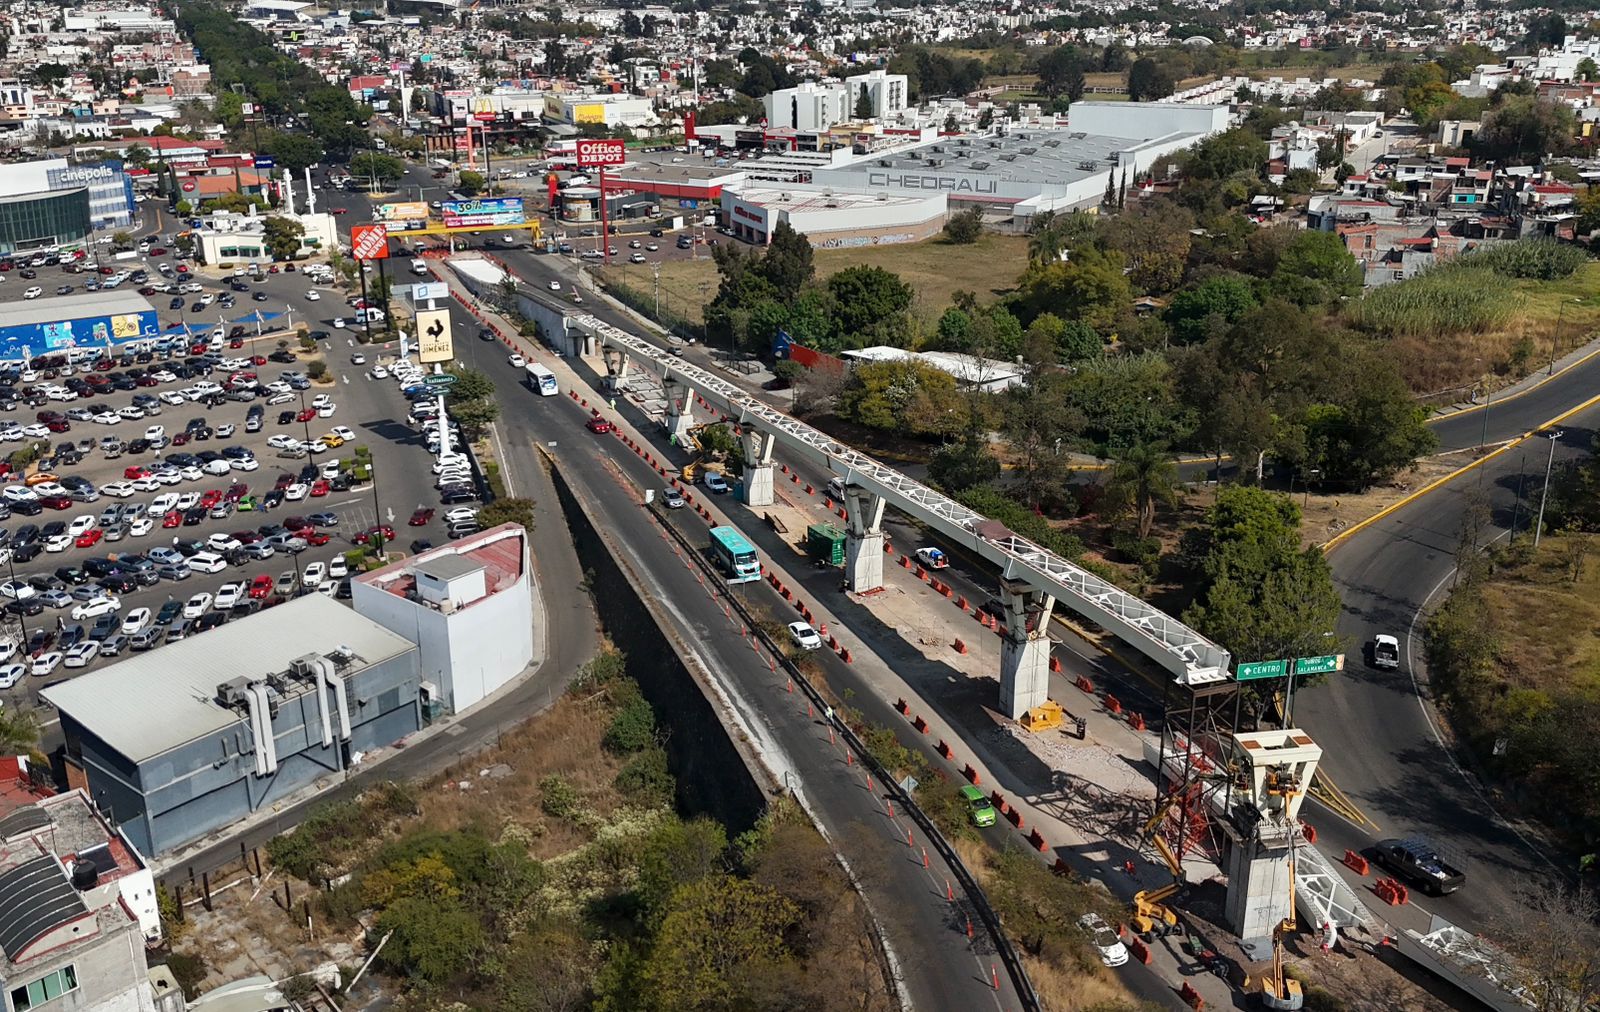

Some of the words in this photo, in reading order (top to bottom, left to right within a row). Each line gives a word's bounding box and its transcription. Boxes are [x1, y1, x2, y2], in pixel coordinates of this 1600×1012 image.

[580, 143, 622, 154] Office
[581, 153, 622, 163] DEPOT
[60, 165, 113, 181] cinépolis
[868, 172, 998, 194] CHEDRAUI
[457, 200, 482, 213] 30%
[353, 224, 386, 259] HOME
[355, 229, 369, 243] THE
[367, 238, 386, 259] DEPOT
[1252, 665, 1281, 674] CENTRO
[1297, 665, 1327, 673] SALAMANCA
